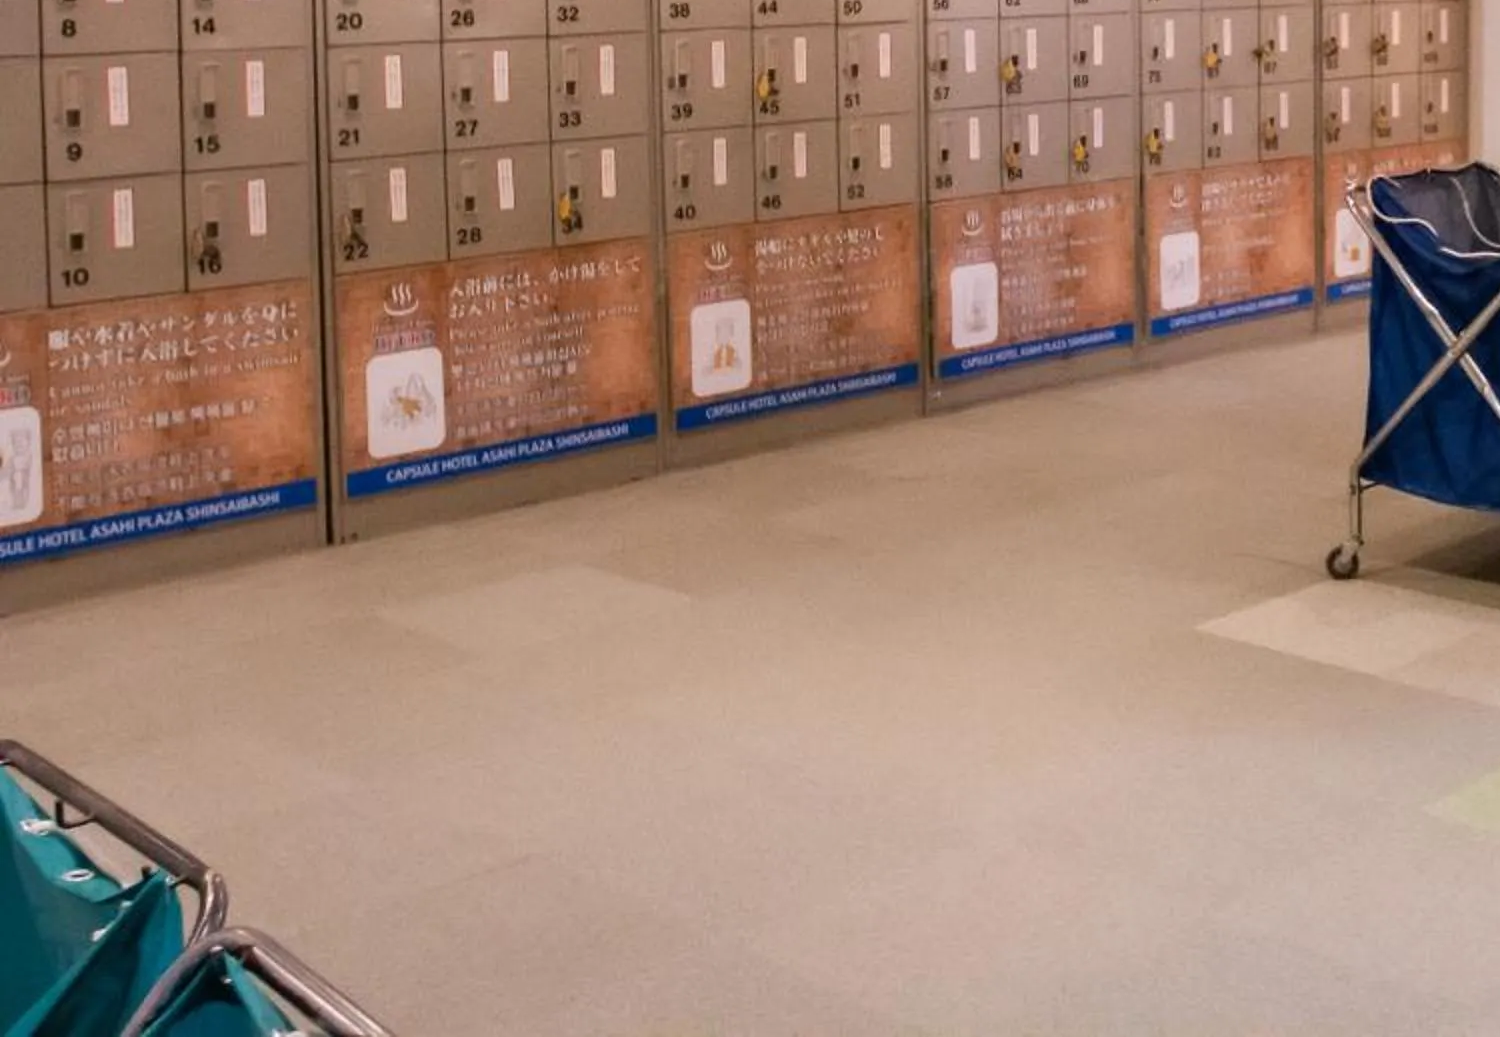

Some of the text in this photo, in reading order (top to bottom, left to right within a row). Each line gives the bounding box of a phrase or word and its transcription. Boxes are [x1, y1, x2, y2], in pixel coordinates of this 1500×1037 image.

[557, 6, 579, 22] 32
[669, 3, 690, 18] 38
[758, 0, 778, 15] 44
[844, 0, 861, 15] 50
[192, 18, 215, 35] 14
[337, 14, 362, 31] 20
[451, 10, 474, 27] 26
[61, 19, 76, 38] 8
[845, 94, 860, 108] 51
[934, 87, 950, 101] 57
[672, 104, 692, 119] 39
[759, 101, 779, 115] 45
[456, 120, 478, 137] 27
[560, 112, 581, 128] 33
[195, 136, 219, 154] 15
[339, 130, 359, 147] 21
[68, 143, 81, 162] 9
[936, 175, 952, 188] 58
[847, 184, 865, 198] 52
[761, 195, 781, 209] 46
[674, 204, 696, 220] 40
[562, 216, 583, 233] 34
[458, 228, 481, 245] 28
[344, 243, 369, 260] 22
[199, 255, 222, 274] 16
[62, 269, 89, 287] 10
[706, 402, 747, 419] CAPSULE
[748, 394, 778, 410] HOTEL
[807, 382, 836, 397] PLAZA
[386, 423, 629, 483] CAPSULE HOTEL ASAHI PLAZA SHINSAIBASHI
[39, 527, 86, 549] HOTEL
[90, 518, 135, 538] ASAHI
[137, 509, 184, 529] PLAZA
[186, 491, 280, 520] SHINSAIBASHI
